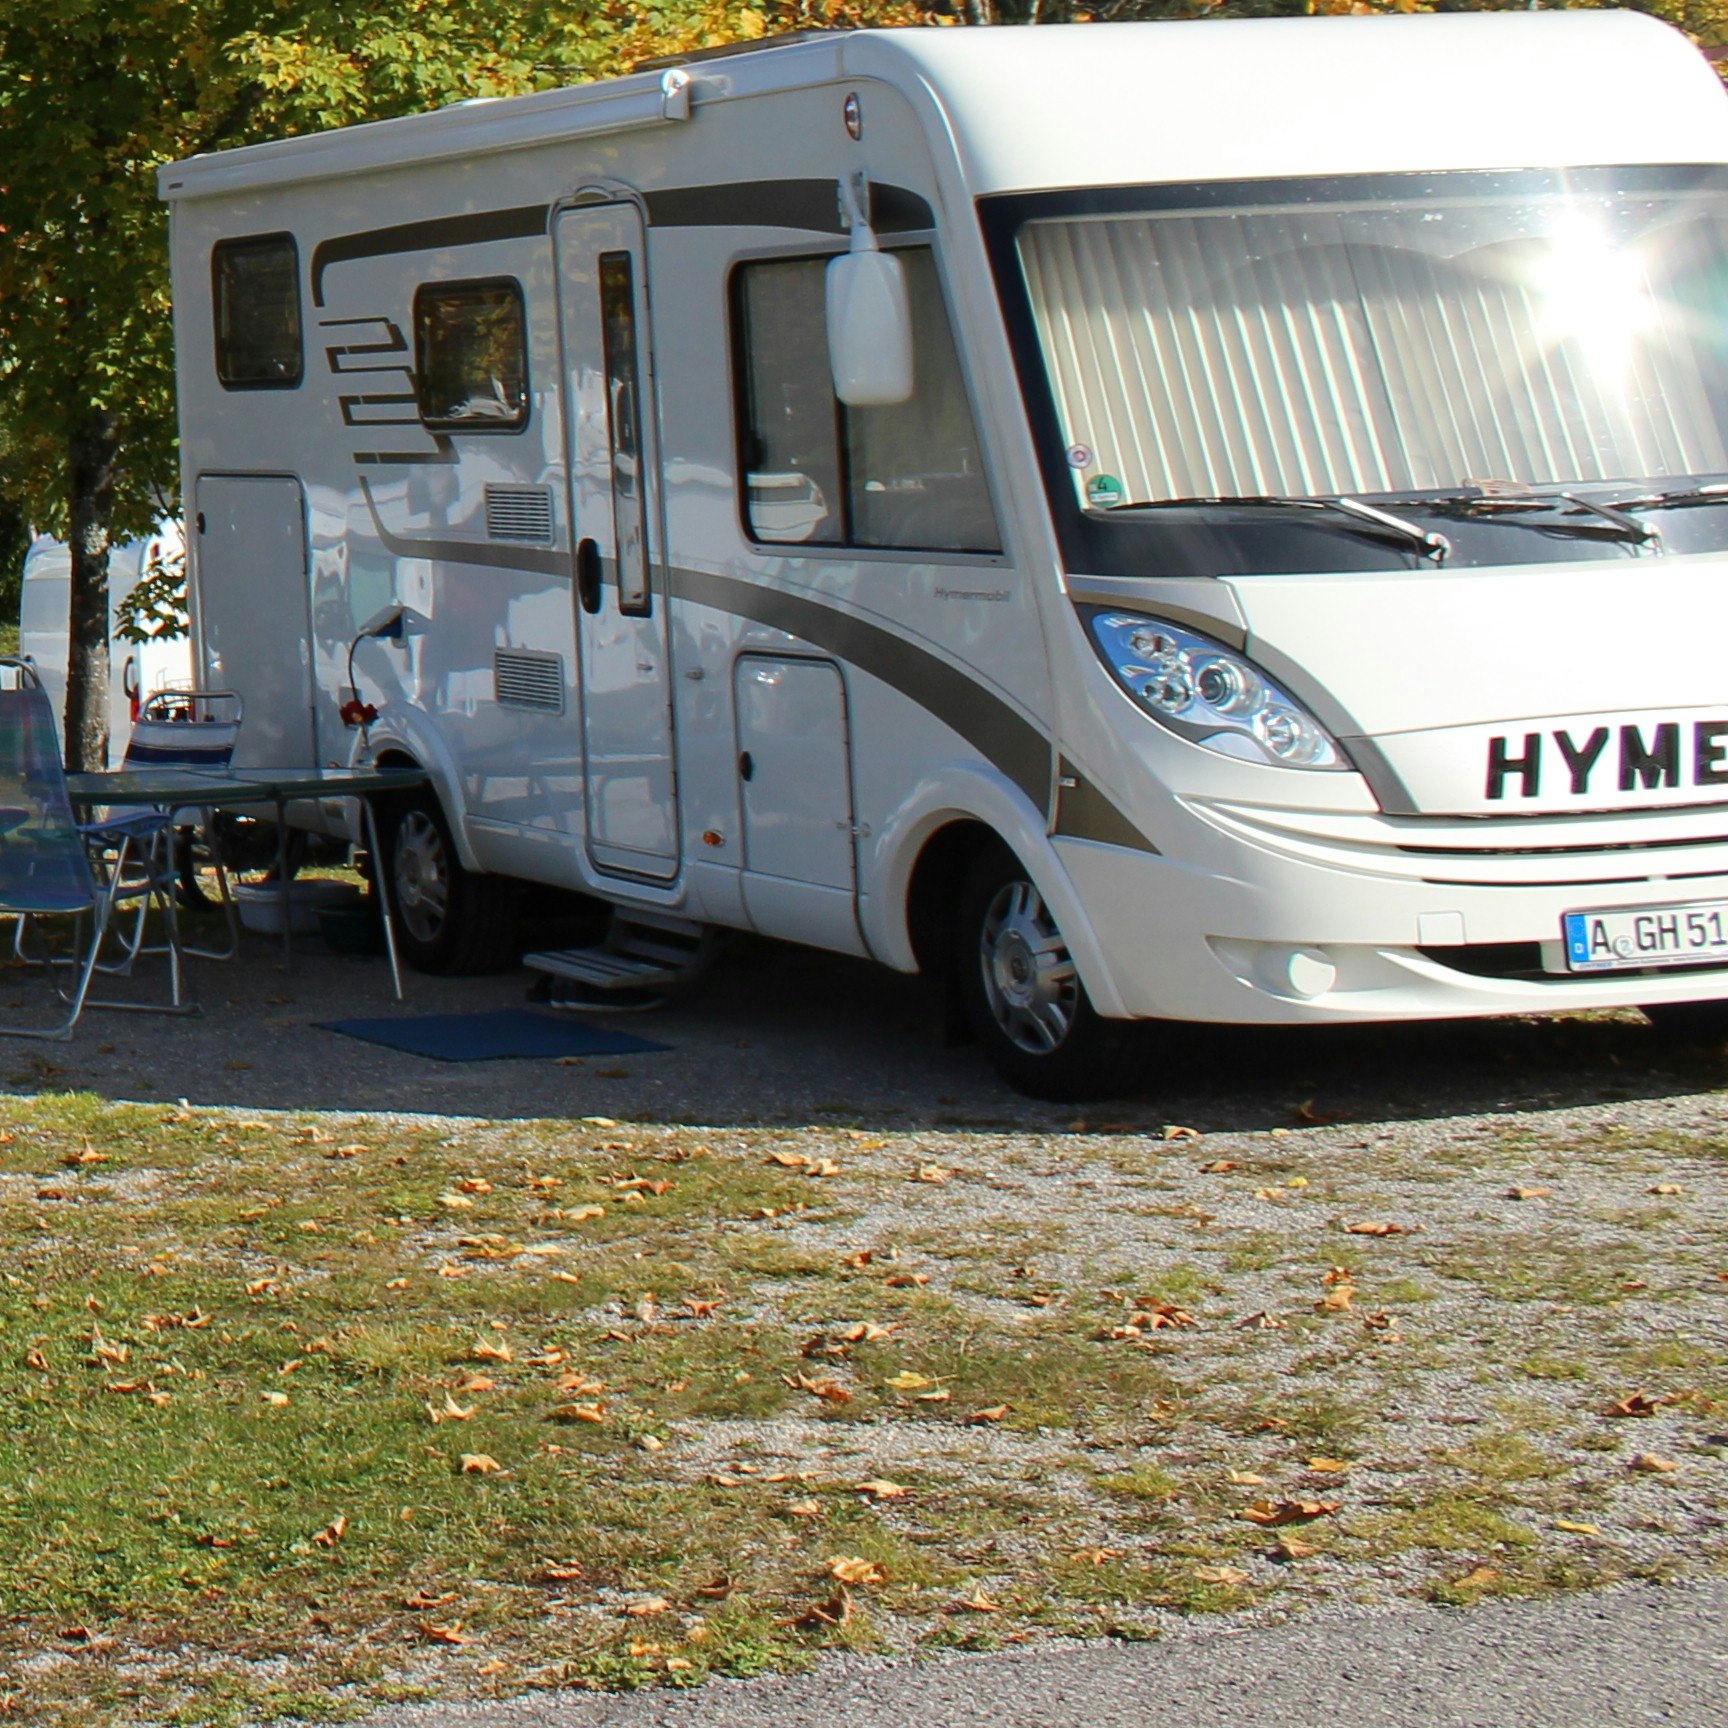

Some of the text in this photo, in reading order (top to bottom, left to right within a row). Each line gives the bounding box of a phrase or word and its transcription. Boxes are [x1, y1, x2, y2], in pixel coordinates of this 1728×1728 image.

[1096, 475, 1108, 491] 4
[1485, 720, 1728, 799] HYME
[1591, 919, 1612, 954] A
[1635, 914, 1680, 951] GH
